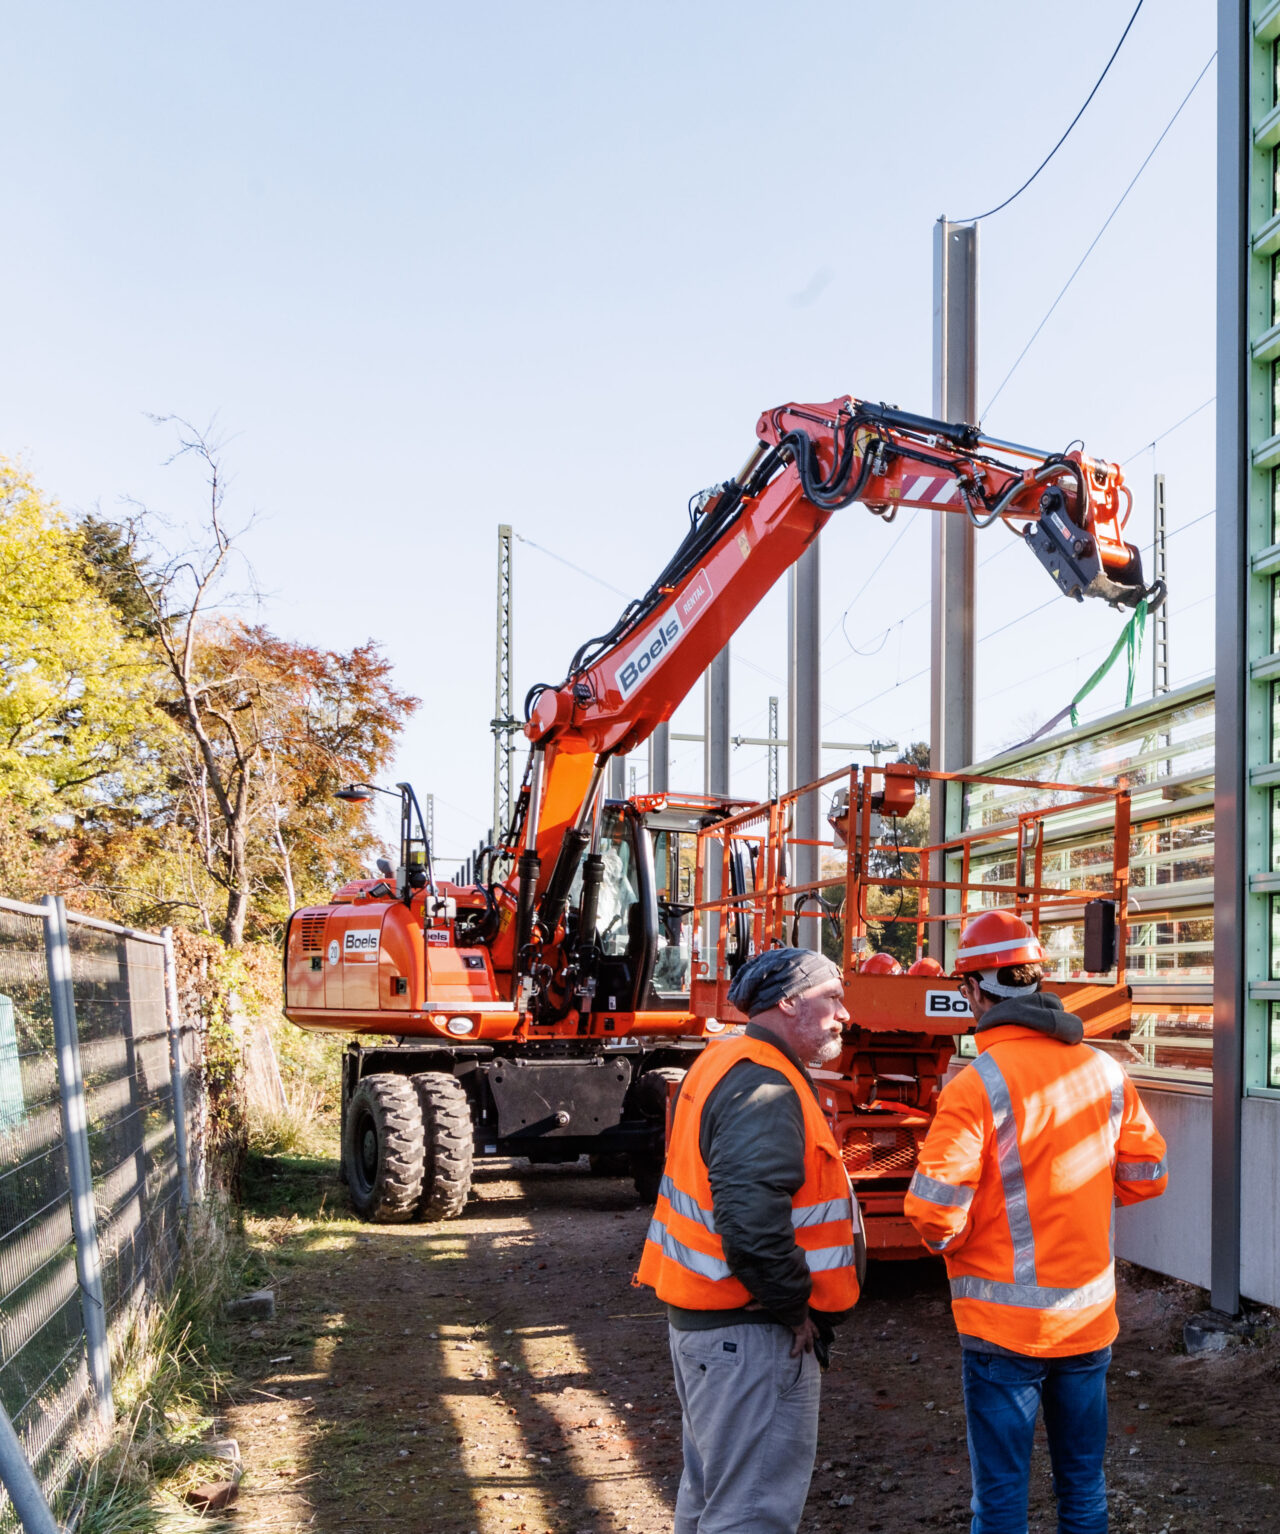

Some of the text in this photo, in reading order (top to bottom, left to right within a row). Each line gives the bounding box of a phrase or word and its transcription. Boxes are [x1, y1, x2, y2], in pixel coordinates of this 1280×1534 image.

[619, 584, 705, 692] Boels RENTAL
[345, 934, 377, 949] Boels
[330, 946, 338, 959] 20
